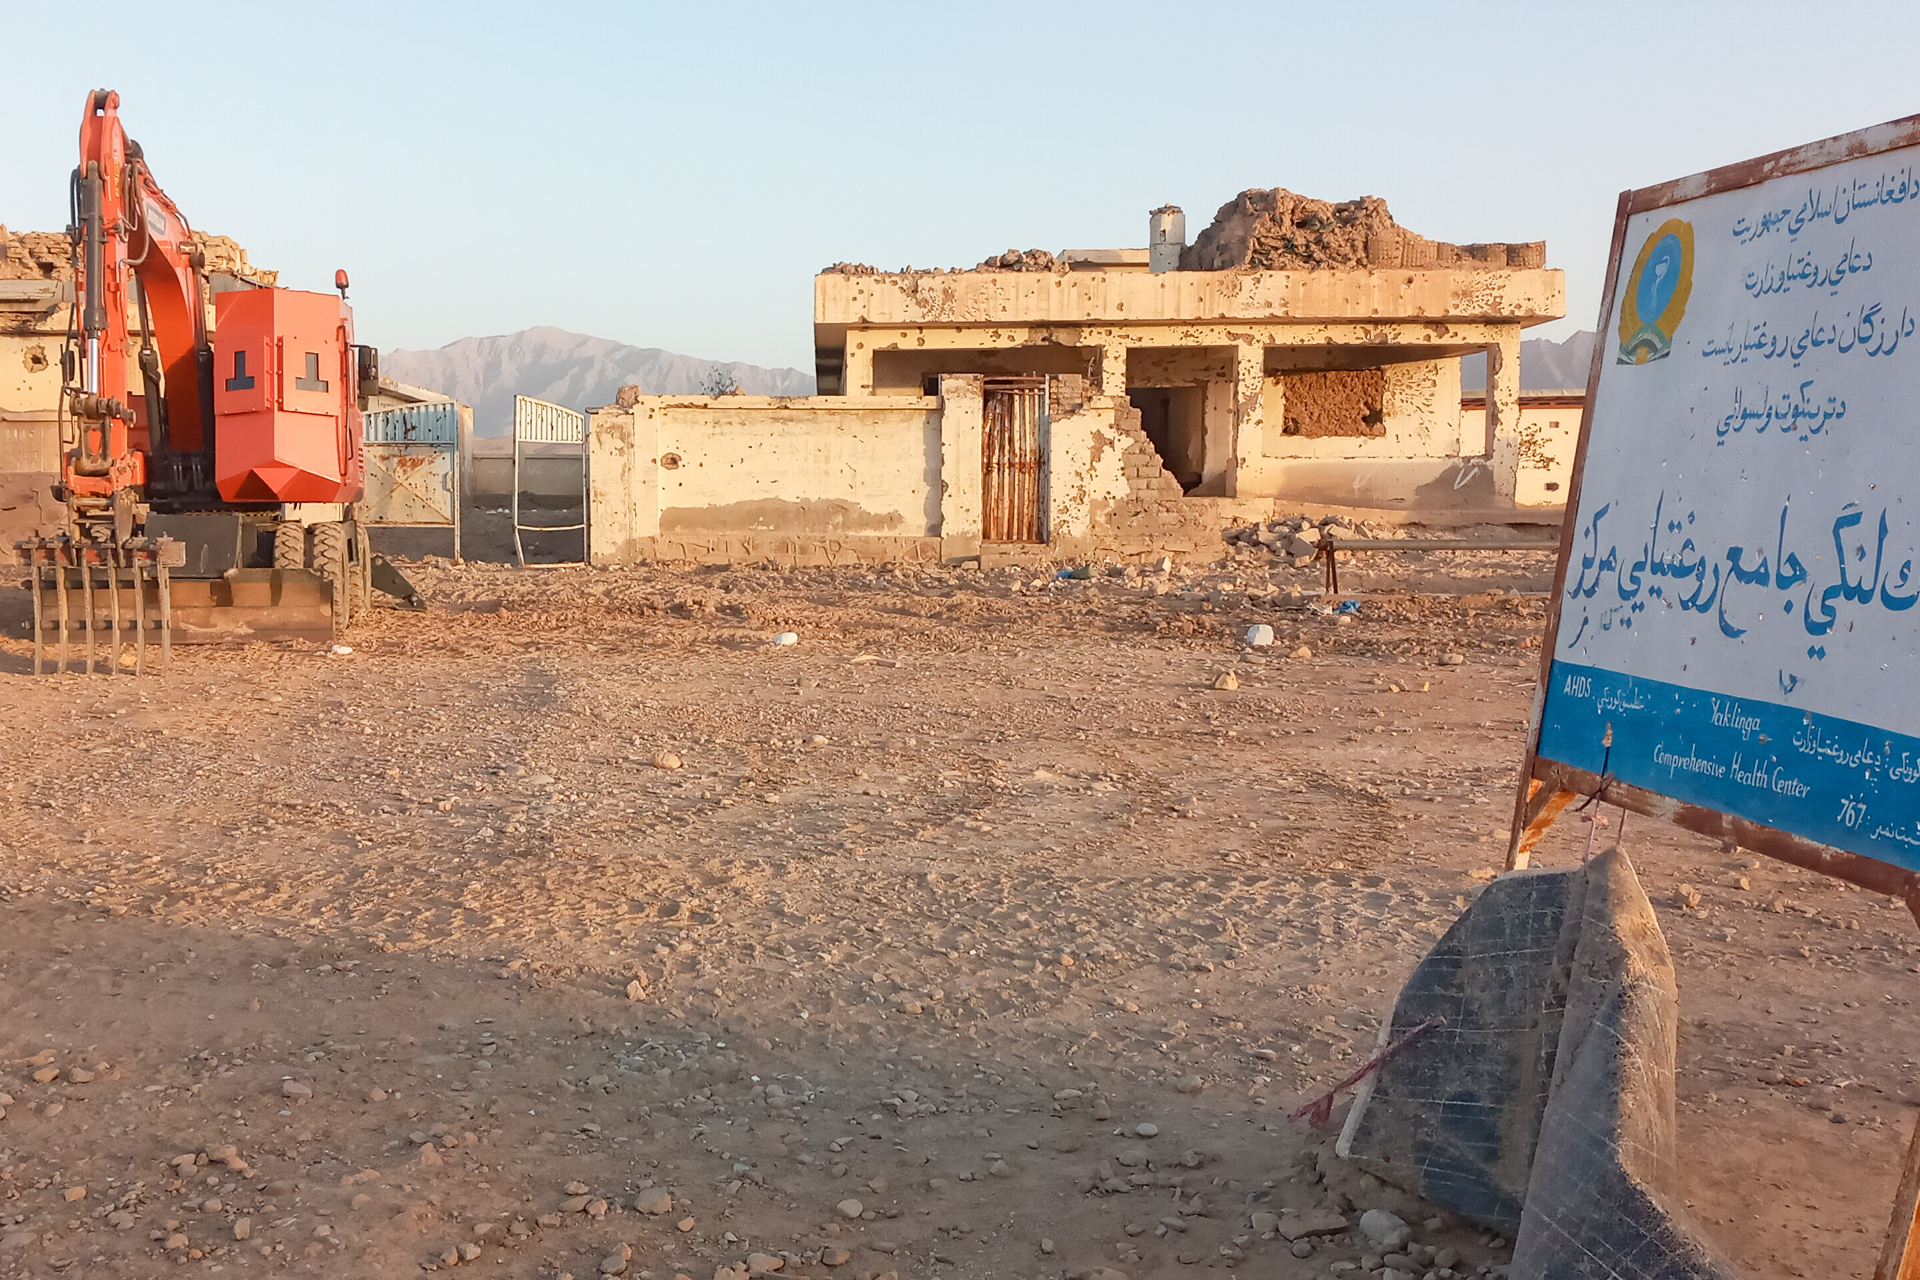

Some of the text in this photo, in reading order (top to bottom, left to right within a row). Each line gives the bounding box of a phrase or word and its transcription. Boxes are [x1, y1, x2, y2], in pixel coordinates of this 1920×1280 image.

[1710, 697, 1761, 741] Yaklinga
[1653, 741, 1811, 798] Comprehensive Health Center
